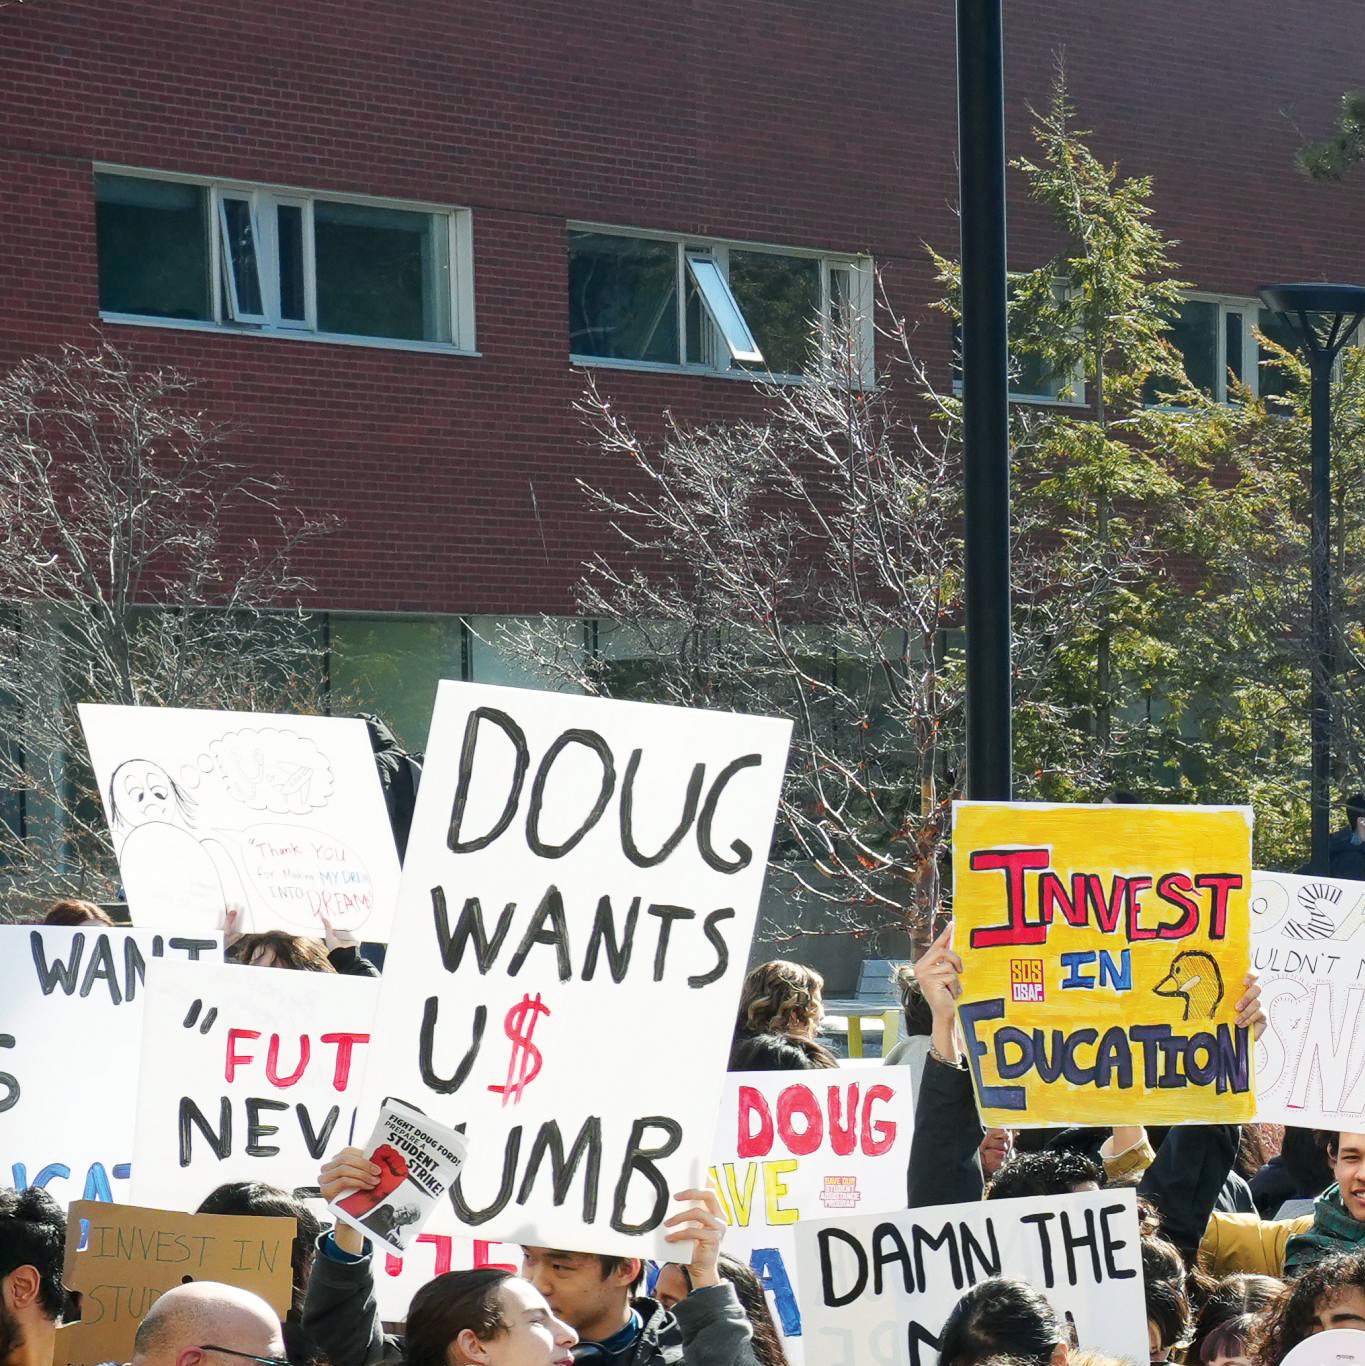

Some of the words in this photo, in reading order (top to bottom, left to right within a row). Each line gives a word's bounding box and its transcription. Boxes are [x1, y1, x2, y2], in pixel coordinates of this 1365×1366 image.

[448, 706, 762, 874] DOUG
[268, 886, 304, 900] INTO
[970, 848, 1243, 948] INVEST
[431, 884, 736, 988] WANTS
[1252, 946, 1341, 975] ULDN'T
[1011, 959, 1043, 983] SOS
[1060, 948, 1132, 992] IN
[418, 993, 551, 1107] U$
[959, 997, 1250, 1111] EDUCATION
[179, 1095, 358, 1168] NEV
[384, 1120, 420, 1146] PREPARE
[420, 1142, 427, 1150] A
[388, 1114, 415, 1132] FIGHT
[414, 1126, 438, 1148] DOUG
[437, 1145, 462, 1167] FORD!
[738, 1081, 897, 1158] DOUG
[386, 1132, 440, 1172] STUDENT
[406, 1158, 446, 1197] STRIKE!
[92, 1226, 217, 1267] INVEST
[232, 1239, 280, 1273] IN
[817, 1218, 1003, 1308] DAMN
[1020, 1203, 1137, 1287] THE
